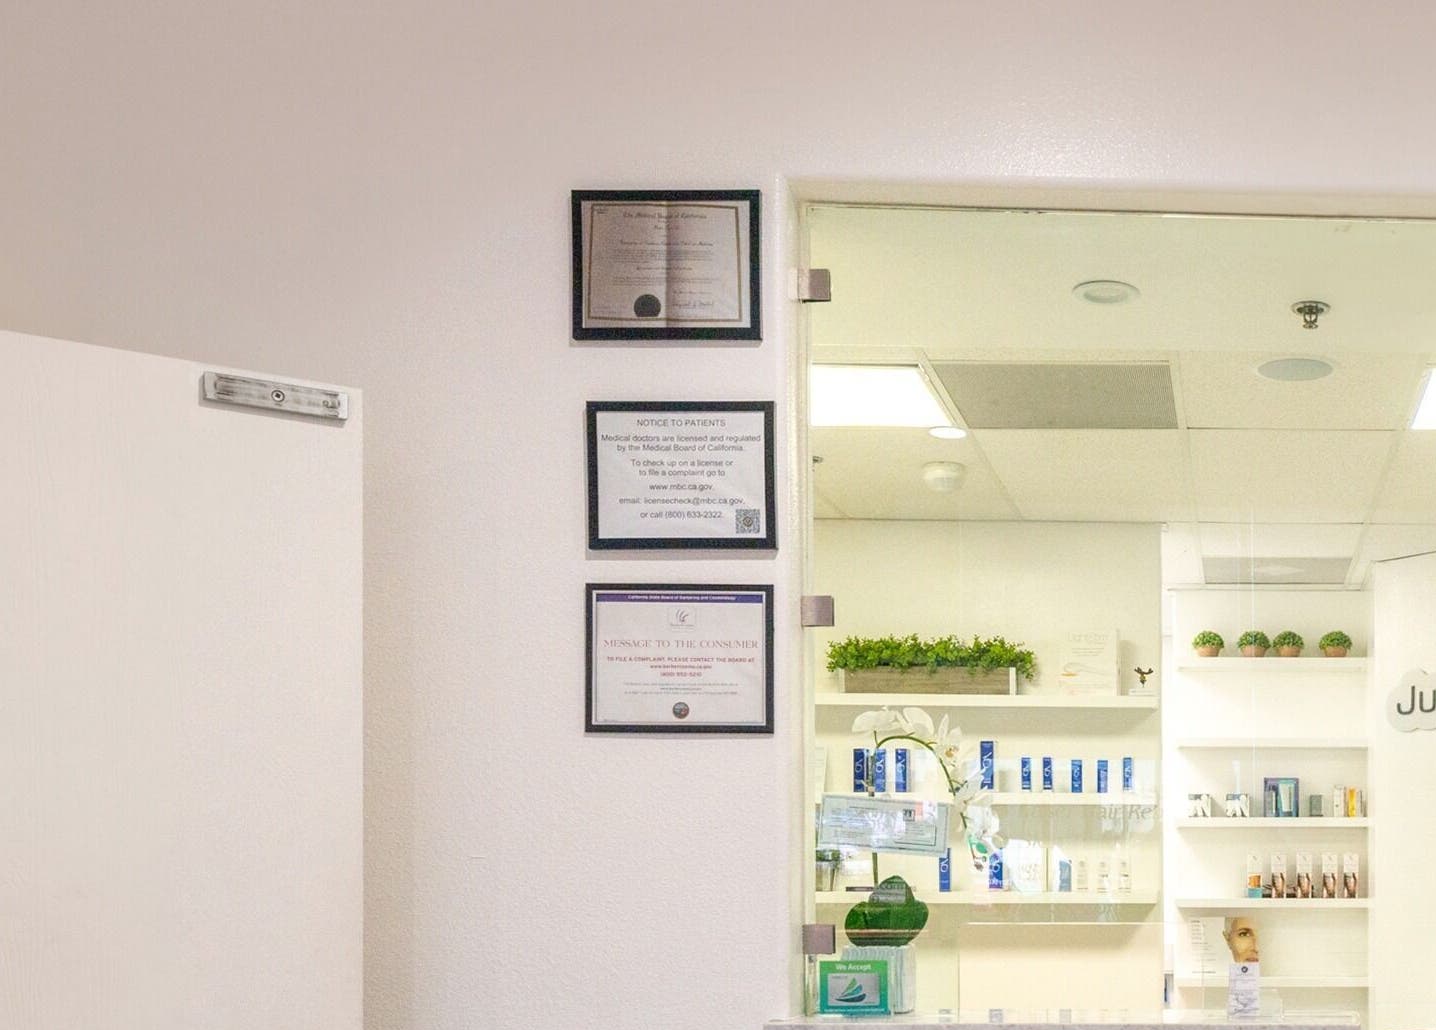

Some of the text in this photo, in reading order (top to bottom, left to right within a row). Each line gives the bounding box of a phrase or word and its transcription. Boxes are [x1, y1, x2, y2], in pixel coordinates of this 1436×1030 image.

[636, 419, 727, 428] NOTICE TO PATIENTS
[600, 434, 631, 442] Medical
[632, 434, 660, 442] doctors
[676, 434, 708, 442] licensed
[709, 434, 724, 442] and
[726, 435, 761, 444] regulated
[616, 444, 626, 453] by
[628, 444, 641, 452] the
[642, 444, 672, 452] Medical
[673, 444, 697, 452] Board
[698, 444, 706, 452] of
[630, 459, 642, 467] To
[642, 459, 665, 467] check
[666, 461, 677, 469] up
[697, 459, 724, 467] license
[668, 469, 705, 479] complaint
[650, 511, 663, 519] call
[603, 639, 759, 649] MESSAGE TO THE CONSUMER
